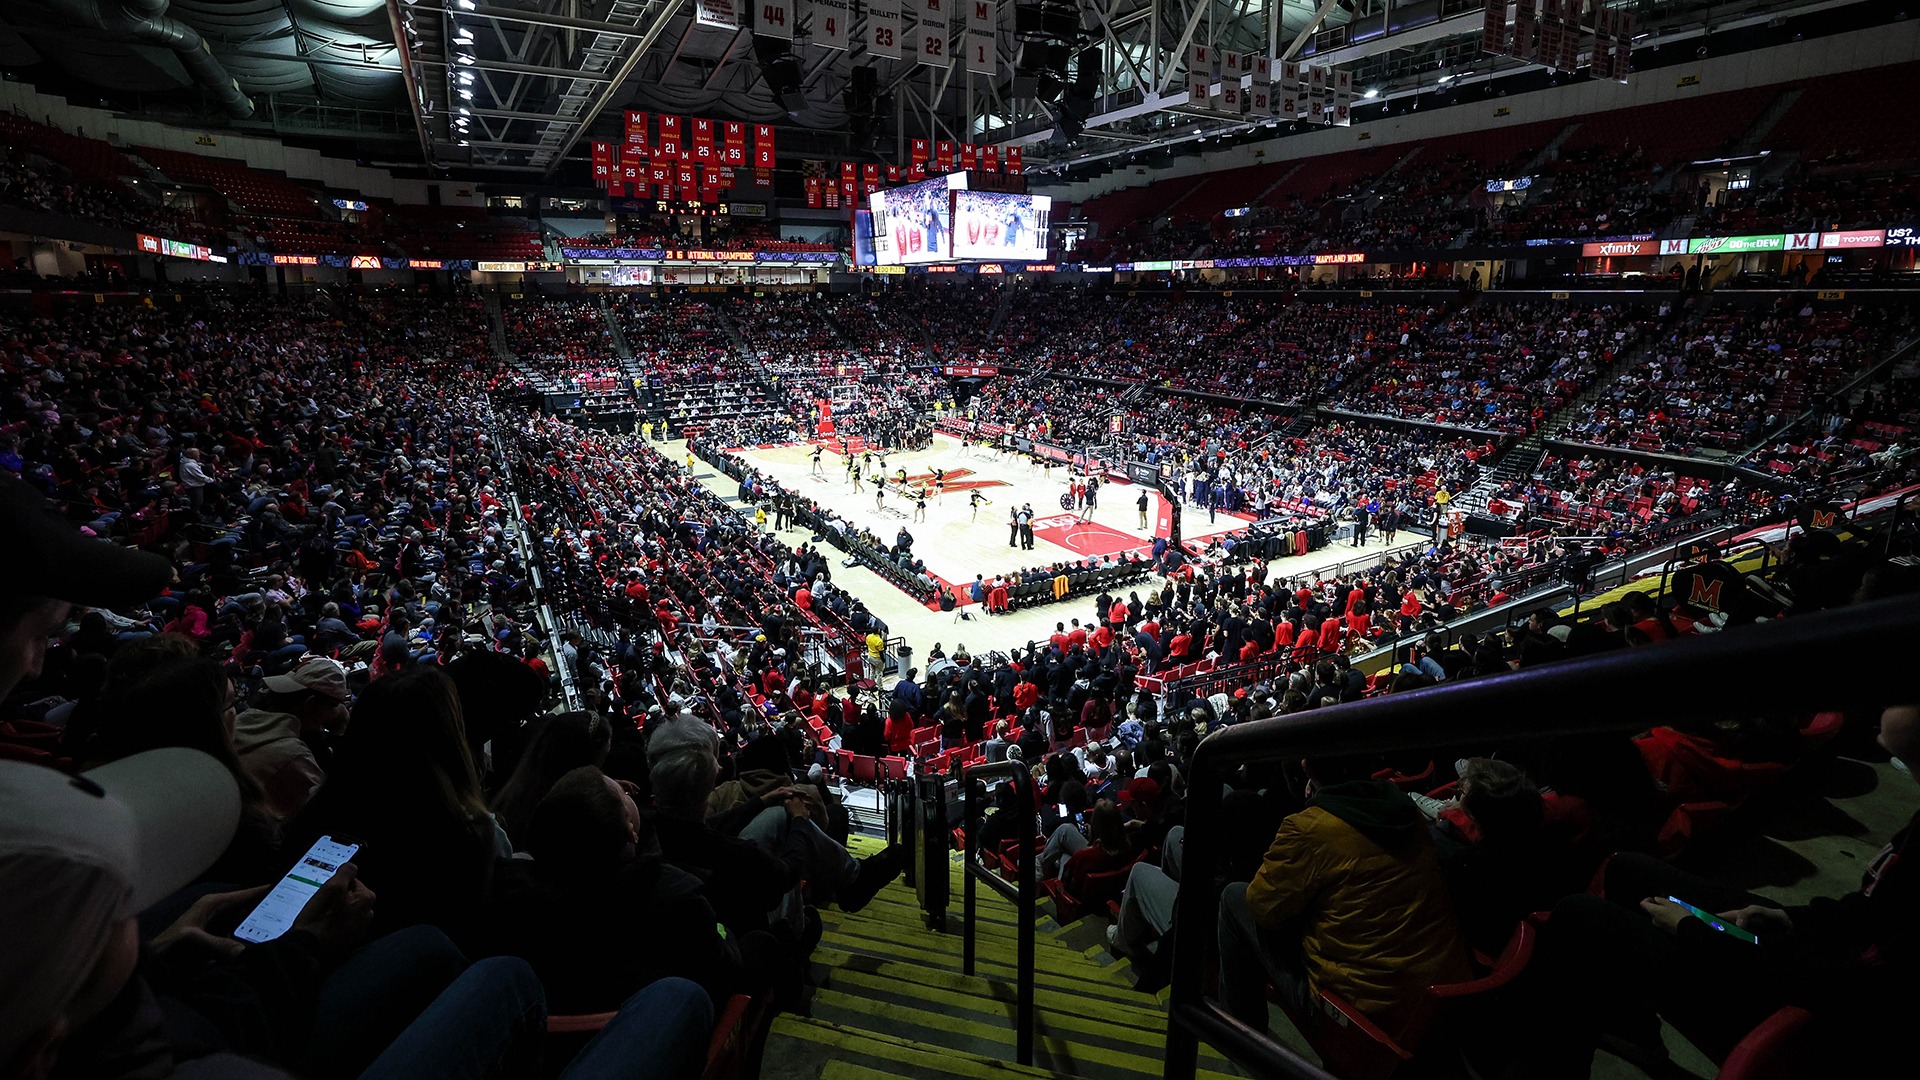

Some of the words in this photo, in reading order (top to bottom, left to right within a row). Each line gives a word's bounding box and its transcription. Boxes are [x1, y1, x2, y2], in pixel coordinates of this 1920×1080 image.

[927, 0, 940, 9] M
[975, 1, 988, 18] M
[763, 5, 785, 27] 44
[869, 8, 899, 20] BULLETT
[825, 17, 836, 37] 4
[922, 18, 946, 30] DORON
[875, 27, 894, 47] 23
[968, 27, 995, 39] LANGHORNE
[925, 36, 942, 56] 22
[977, 46, 985, 63] 1
[1196, 47, 1206, 61] M
[1227, 54, 1236, 68] M
[1258, 59, 1267, 73] M
[1286, 65, 1295, 78] M
[1314, 69, 1322, 82] M
[1340, 73, 1348, 86] M
[1195, 84, 1206, 99] 15
[1225, 89, 1236, 104] 25
[1255, 94, 1266, 109] 20
[1284, 98, 1295, 113] 25
[1312, 102, 1322, 116] 32
[1337, 105, 1348, 119] 42
[632, 113, 641, 124] M
[665, 116, 675, 127] M
[698, 120, 708, 131] M
[730, 123, 739, 134] M
[760, 126, 769, 137] M
[597, 143, 605, 153] M
[665, 142, 676, 155] 21
[698, 145, 709, 157] 25
[916, 141, 924, 150] M
[681, 151, 689, 161] M
[729, 148, 741, 160] 35
[762, 151, 768, 162] 3
[596, 165, 608, 176] 34
[612, 164, 620, 173] M
[625, 167, 637, 178] 25
[941, 165, 950, 173] 15
[653, 170, 664, 180] 52
[681, 172, 691, 182] 55
[708, 174, 718, 184] 15
[756, 178, 770, 186] 2002
[845, 183, 854, 192] 41
[867, 184, 876, 193] 54
[658, 204, 667, 212] 27
[719, 206, 728, 214] 23
[732, 206, 765, 214] SUBWAY
[1842, 235, 1881, 243] TOYOTA
[1887, 228, 1913, 238] US?
[1667, 240, 1681, 252] M
[1729, 240, 1743, 249] DO
[1756, 239, 1780, 247] DEW
[1793, 234, 1810, 247] M
[1599, 242, 1641, 256] xfinity
[274, 255, 287, 263] FEAR
[288, 256, 298, 264] THE
[299, 256, 317, 264] TURTLE
[717, 251, 754, 260] CHAMPIONS
[1315, 254, 1346, 264] MARYLAND
[1813, 510, 1835, 527] M
[1689, 574, 1723, 608] M
